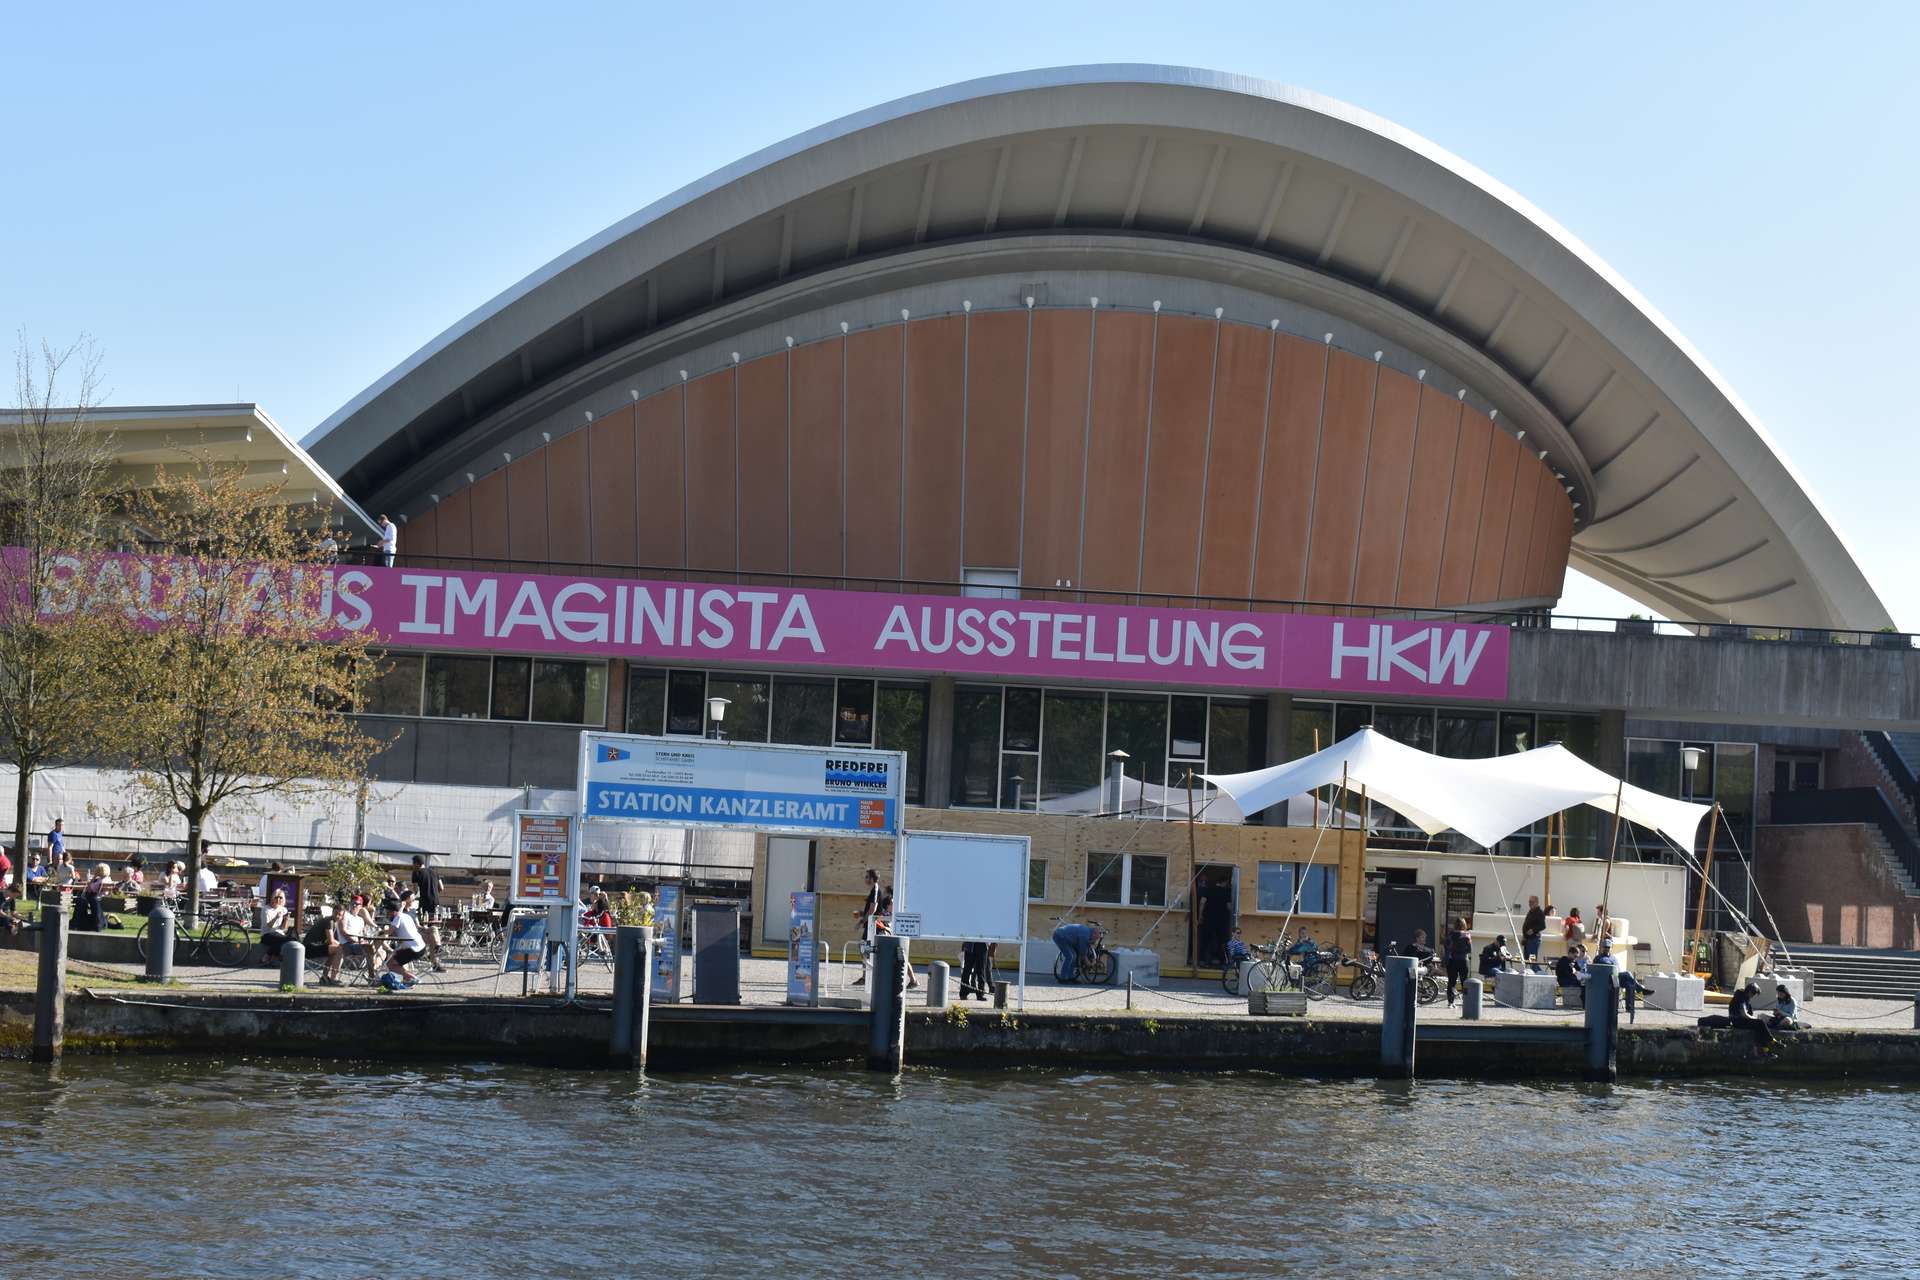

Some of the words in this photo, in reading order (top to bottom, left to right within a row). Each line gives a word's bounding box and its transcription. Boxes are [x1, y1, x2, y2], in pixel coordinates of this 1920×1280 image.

[399, 574, 826, 653] IMAGINISTA
[874, 605, 1265, 670] AUSSTELLUNG
[1331, 622, 1491, 686] HKW
[826, 759, 888, 774] REEDEREI
[825, 778, 852, 786] BRUNO
[854, 780, 887, 789] WINKLER
[598, 790, 692, 813] STATION
[700, 795, 850, 822] KANZLERAMT
[511, 938, 542, 951] TICKETS
